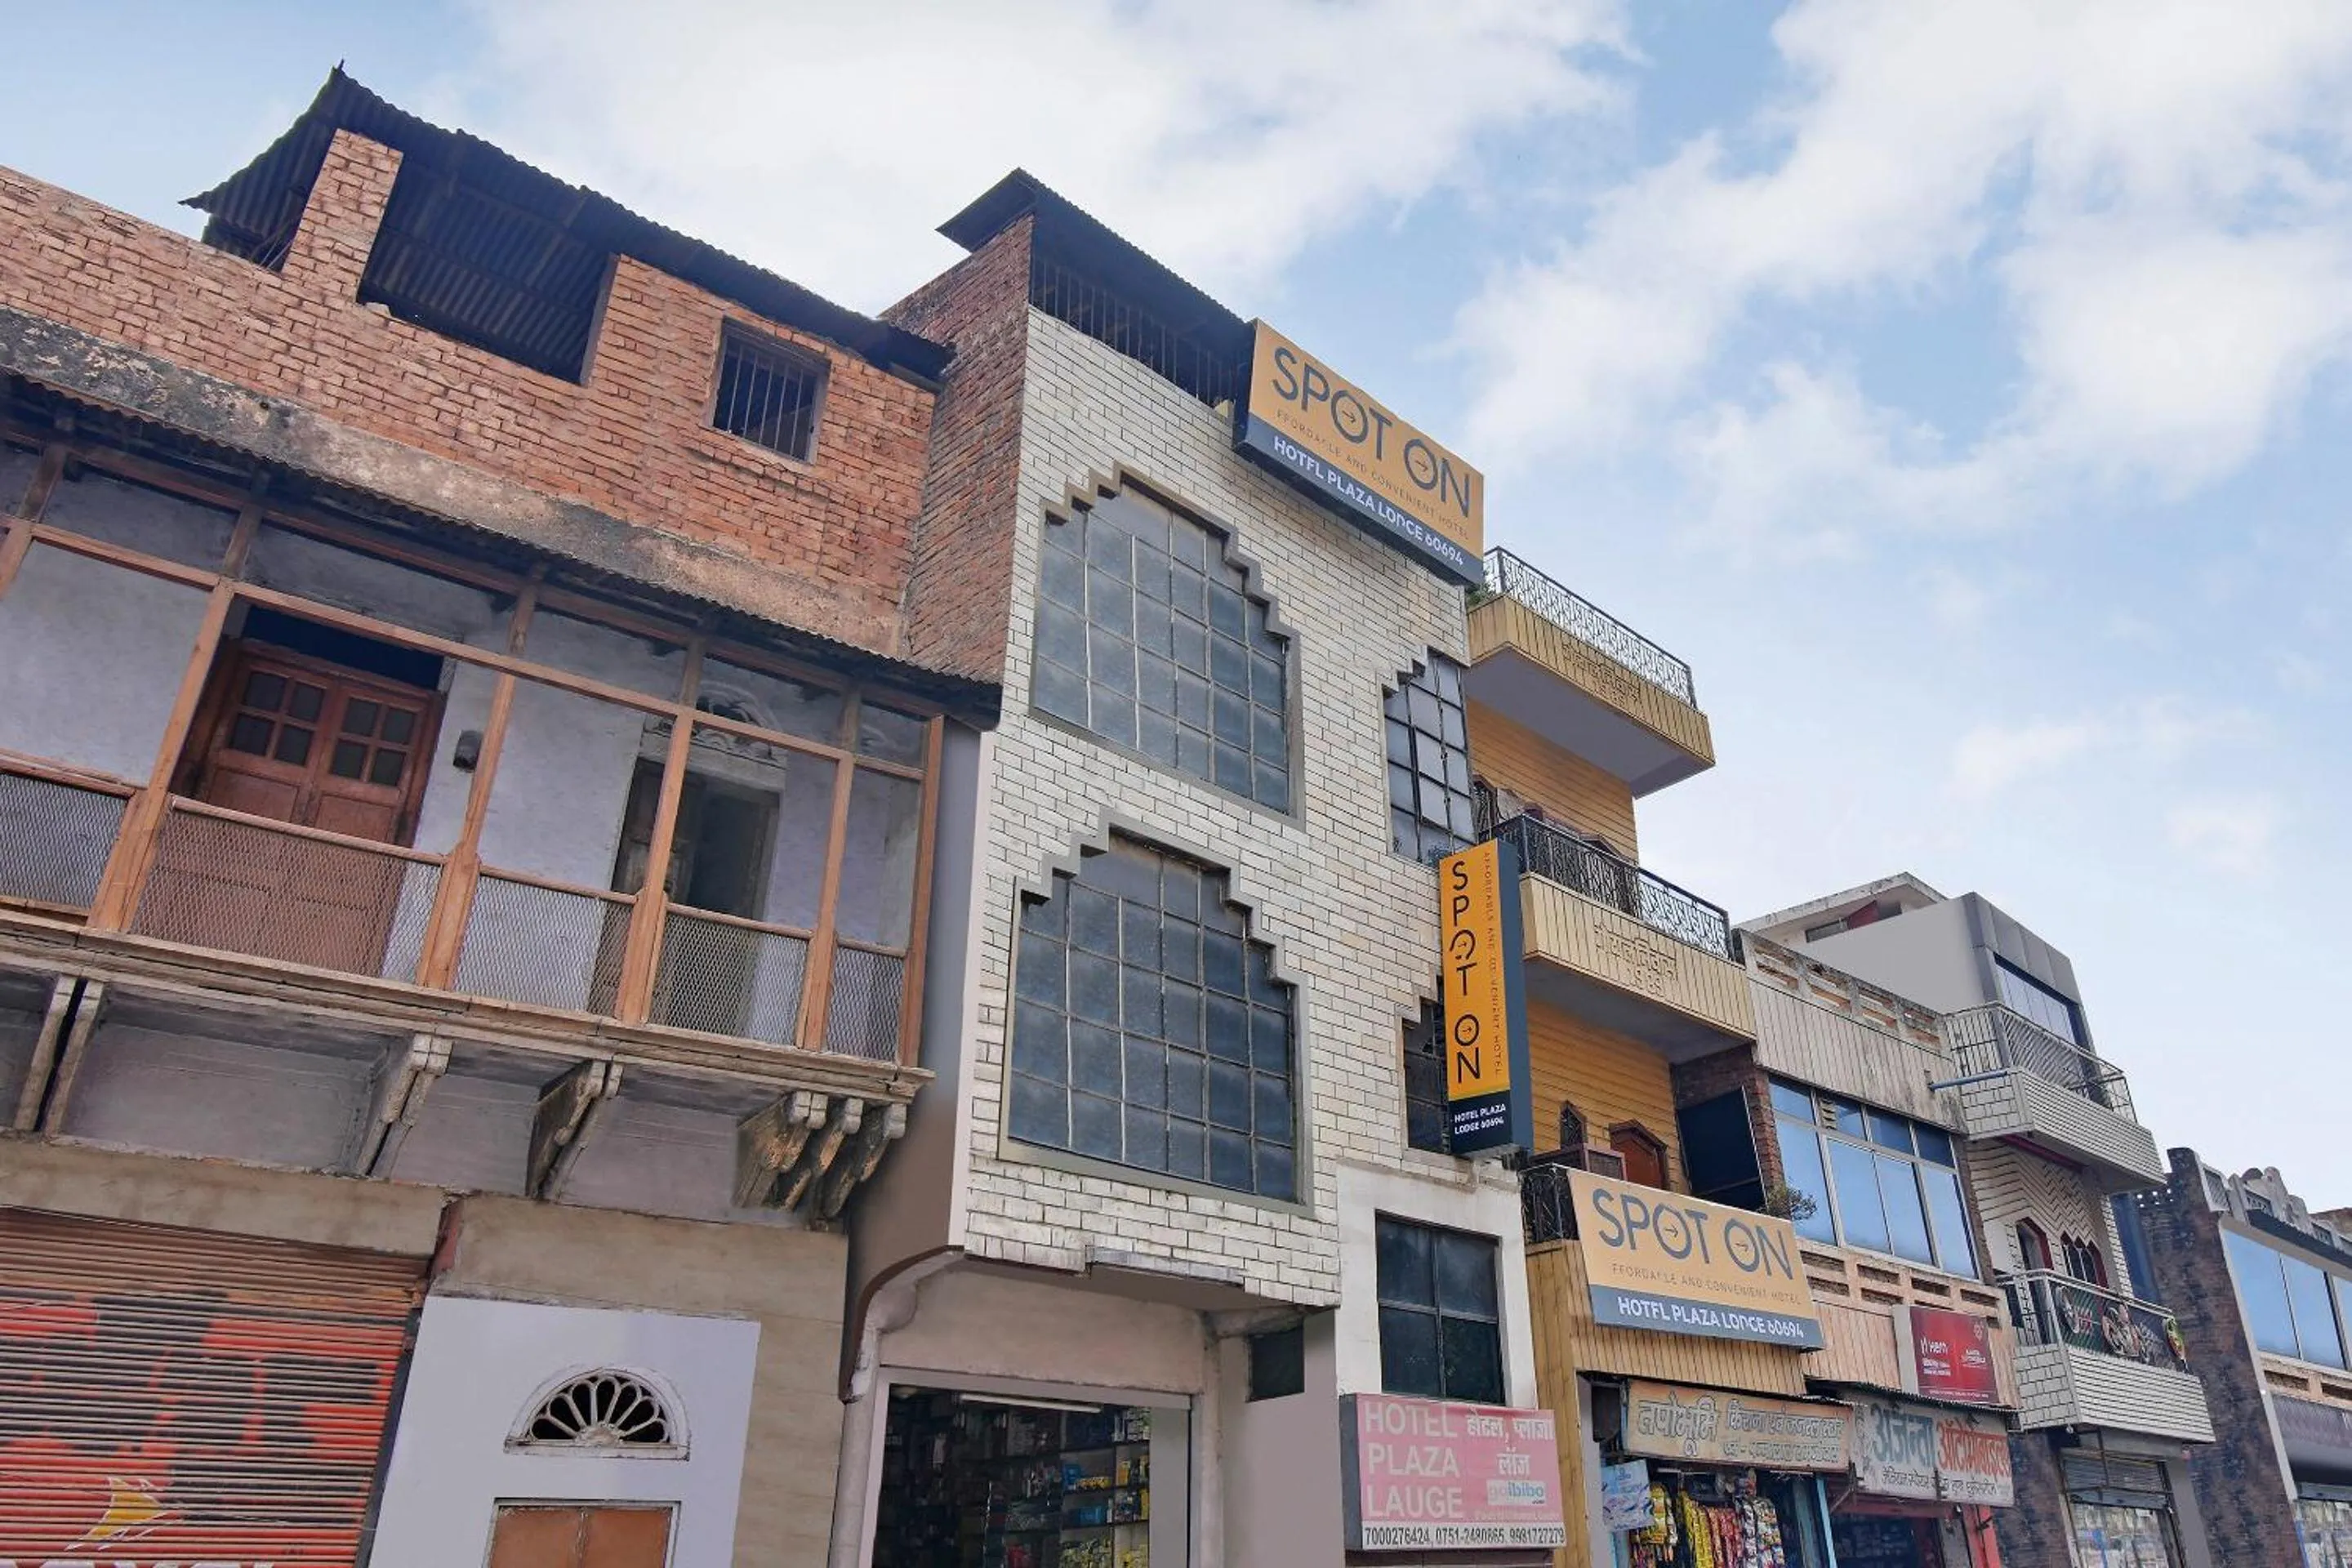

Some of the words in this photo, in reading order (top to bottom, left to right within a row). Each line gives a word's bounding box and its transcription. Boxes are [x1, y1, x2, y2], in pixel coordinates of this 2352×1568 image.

[1272, 346, 1393, 461] SPOT
[1403, 438, 1471, 519] ON
[1327, 470, 1376, 512] PLAZA
[1449, 861, 1477, 996] SPOT
[1454, 1013, 1481, 1084] ON
[1454, 1109, 1479, 1124] HOTEL
[1480, 1103, 1506, 1116] PLAZA
[1454, 1121, 1480, 1135] LODGE
[1592, 1188, 1711, 1265] SPOT
[1724, 1218, 1793, 1280] ON
[1673, 1305, 1721, 1328] PLAZA
[1364, 1402, 1459, 1438] HOTEL
[1367, 1442, 1461, 1478] PLAZA
[1365, 1484, 1464, 1519] LAUGE
[1488, 1481, 1544, 1501] goibibo
